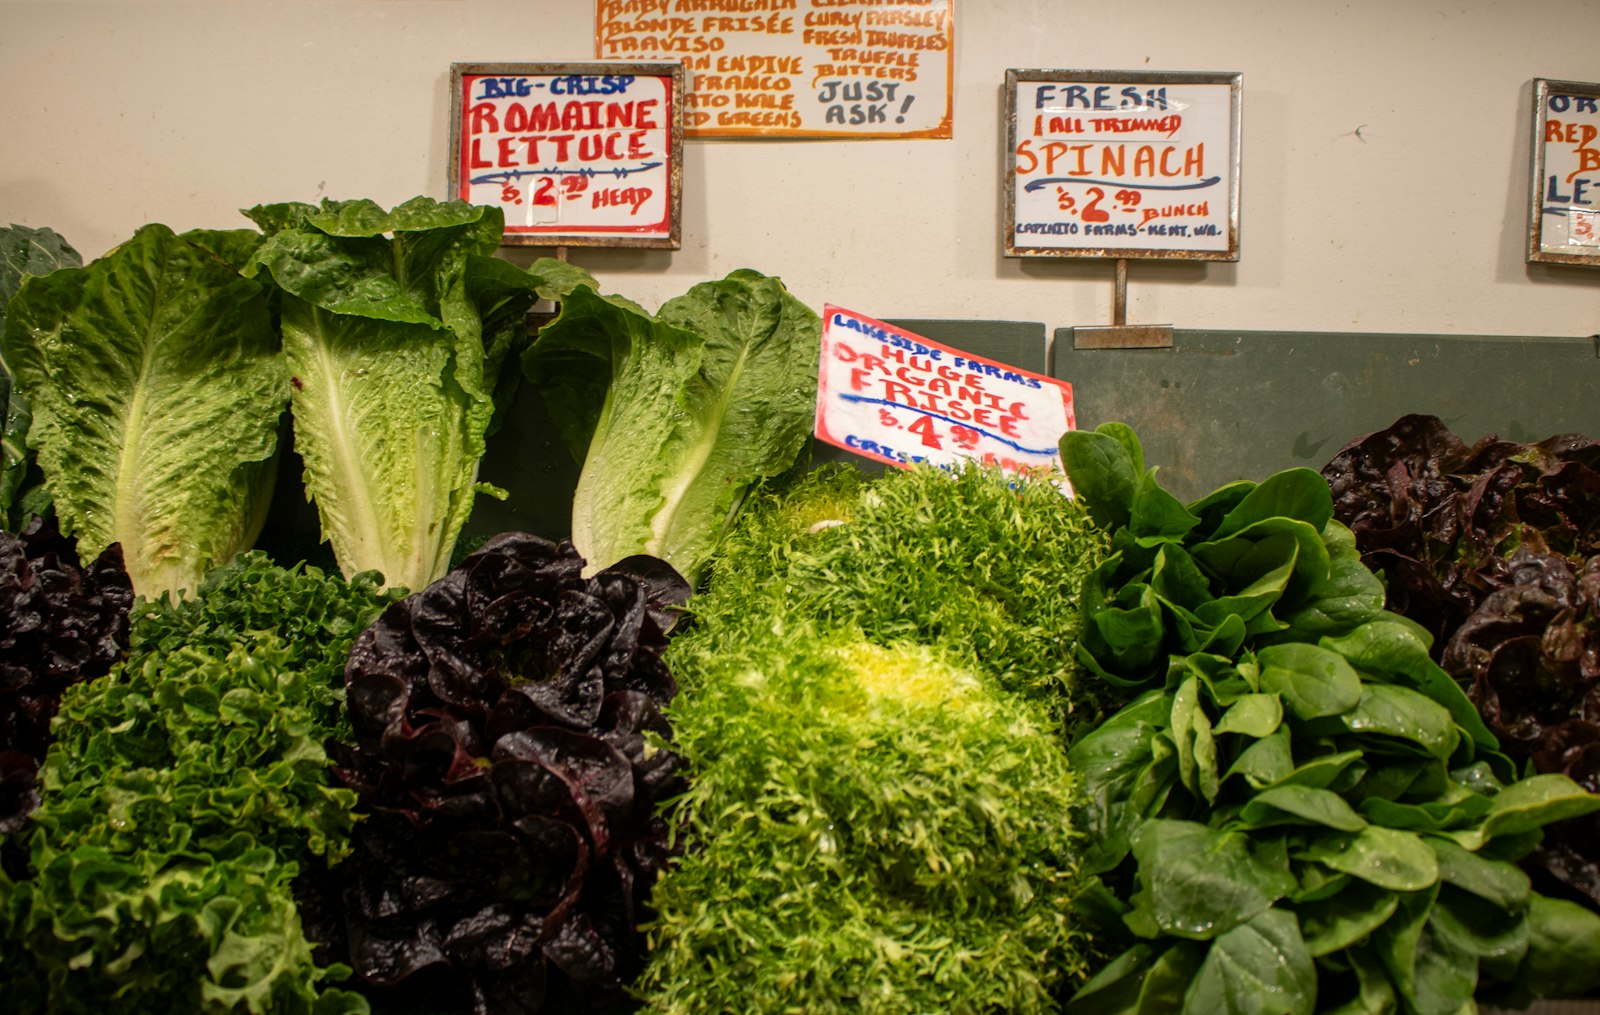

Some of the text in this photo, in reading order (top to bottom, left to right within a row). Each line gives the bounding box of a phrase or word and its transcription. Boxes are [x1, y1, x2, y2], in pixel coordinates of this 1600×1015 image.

[604, 0, 669, 20] BABY
[804, 10, 946, 31] CURLY PARSLEY
[602, 12, 794, 38] BLONDE FRISÉE
[604, 36, 725, 53] TRAVISO
[803, 29, 948, 51] FRESH TRUFFLES
[717, 55, 803, 75] ENDIVE
[827, 49, 920, 67] TRUFFLE
[693, 74, 791, 92] FRANCO
[812, 64, 917, 88] BUTTERS
[683, 93, 795, 110] ATO KALE
[818, 81, 900, 103] JUST
[1035, 85, 1168, 111] FRESH
[470, 99, 659, 135] ROMAINE
[717, 111, 802, 128] GREENS
[1049, 116, 1085, 133] ALL
[1088, 114, 1182, 139] TRIMMED
[1545, 120, 1598, 151] RED
[470, 130, 653, 169] LETTUCE
[1015, 139, 1204, 177] SPINACH
[592, 187, 653, 215] HEAD
[1136, 201, 1209, 229] BUNCH
[834, 314, 1042, 389] LAKESIDE FARMS
[881, 344, 985, 391] HUGE
[834, 341, 1029, 421] ORGANIC
[850, 367, 1022, 439] FRISEE
